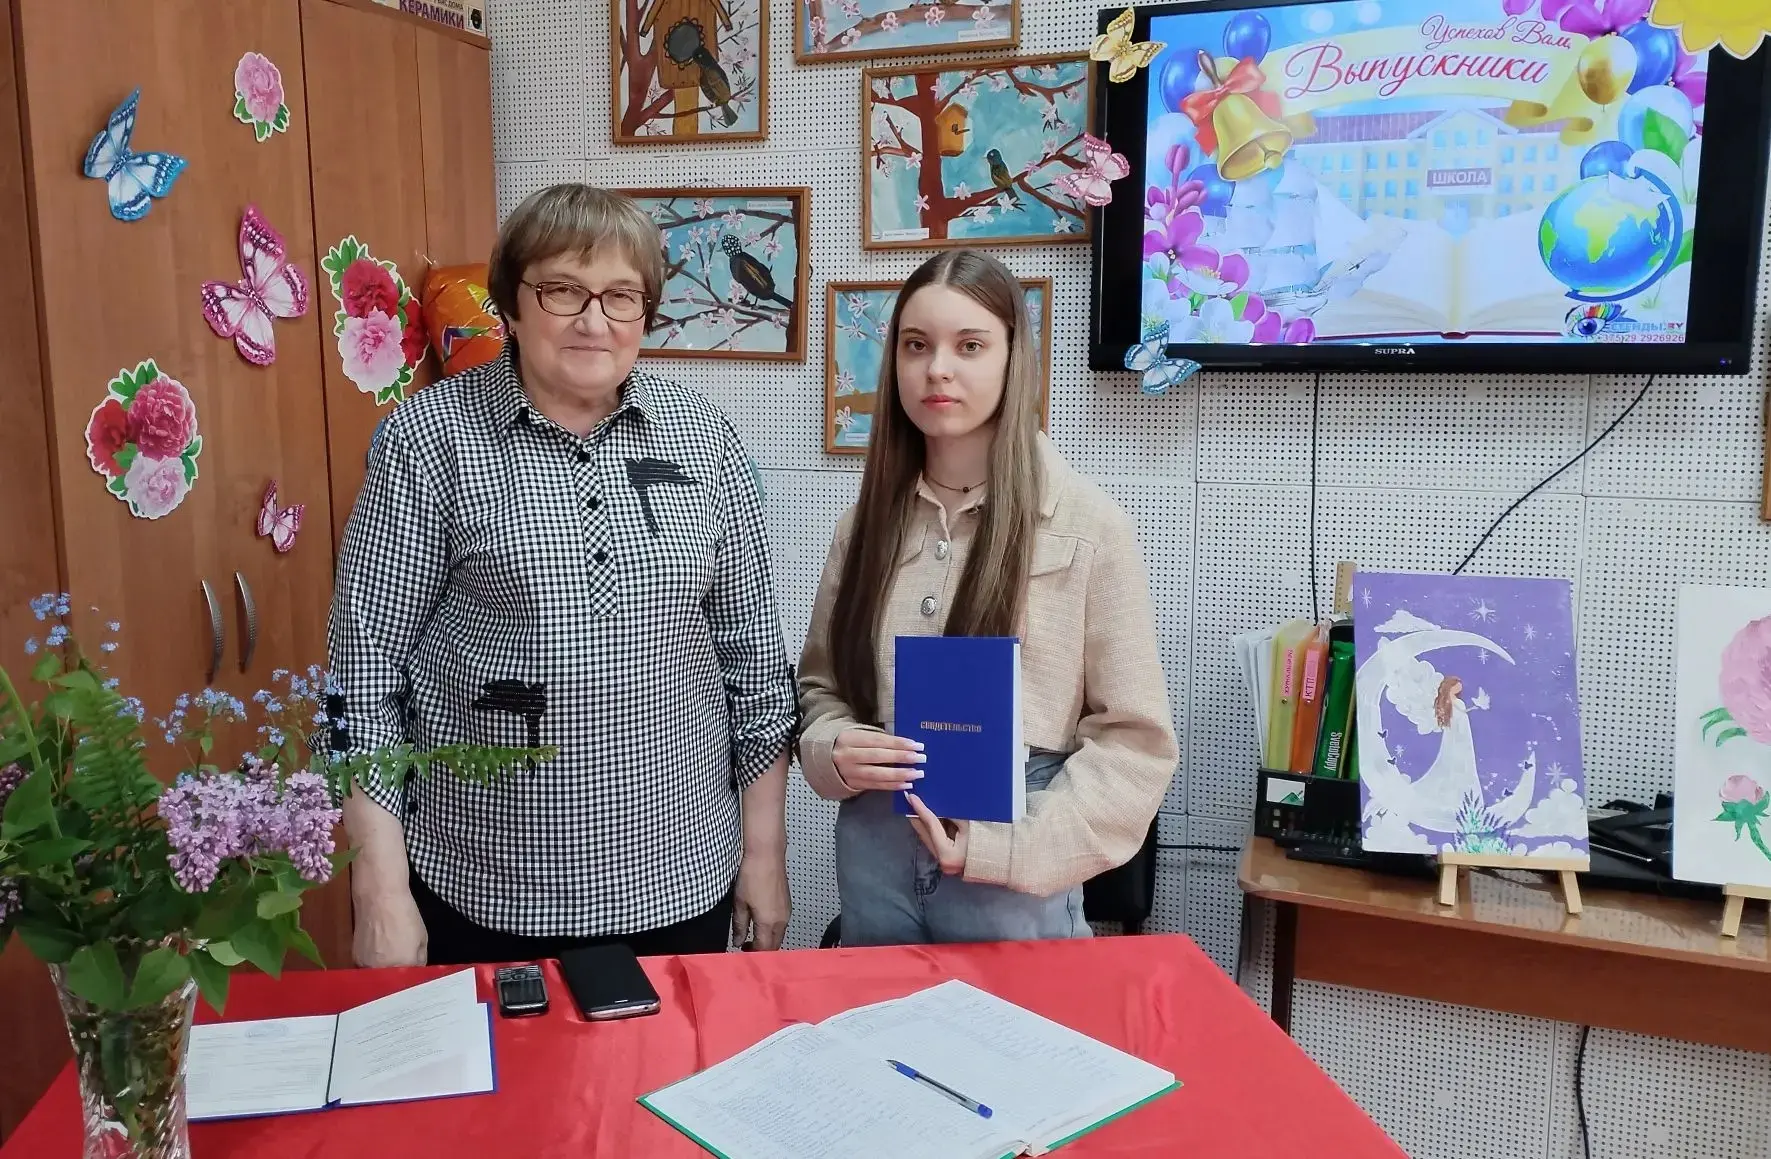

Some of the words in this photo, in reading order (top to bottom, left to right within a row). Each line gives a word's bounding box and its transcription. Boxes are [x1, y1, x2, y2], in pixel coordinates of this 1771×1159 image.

[399, 0, 464, 29] КЕРАМИКИ
[1421, 14, 1517, 50] Успехов
[1284, 42, 1549, 99] Выпускники
[1432, 171, 1488, 185] ШКОЛА
[1640, 334, 1684, 343] 2926926
[1324, 732, 1342, 771] SvetoCopy
